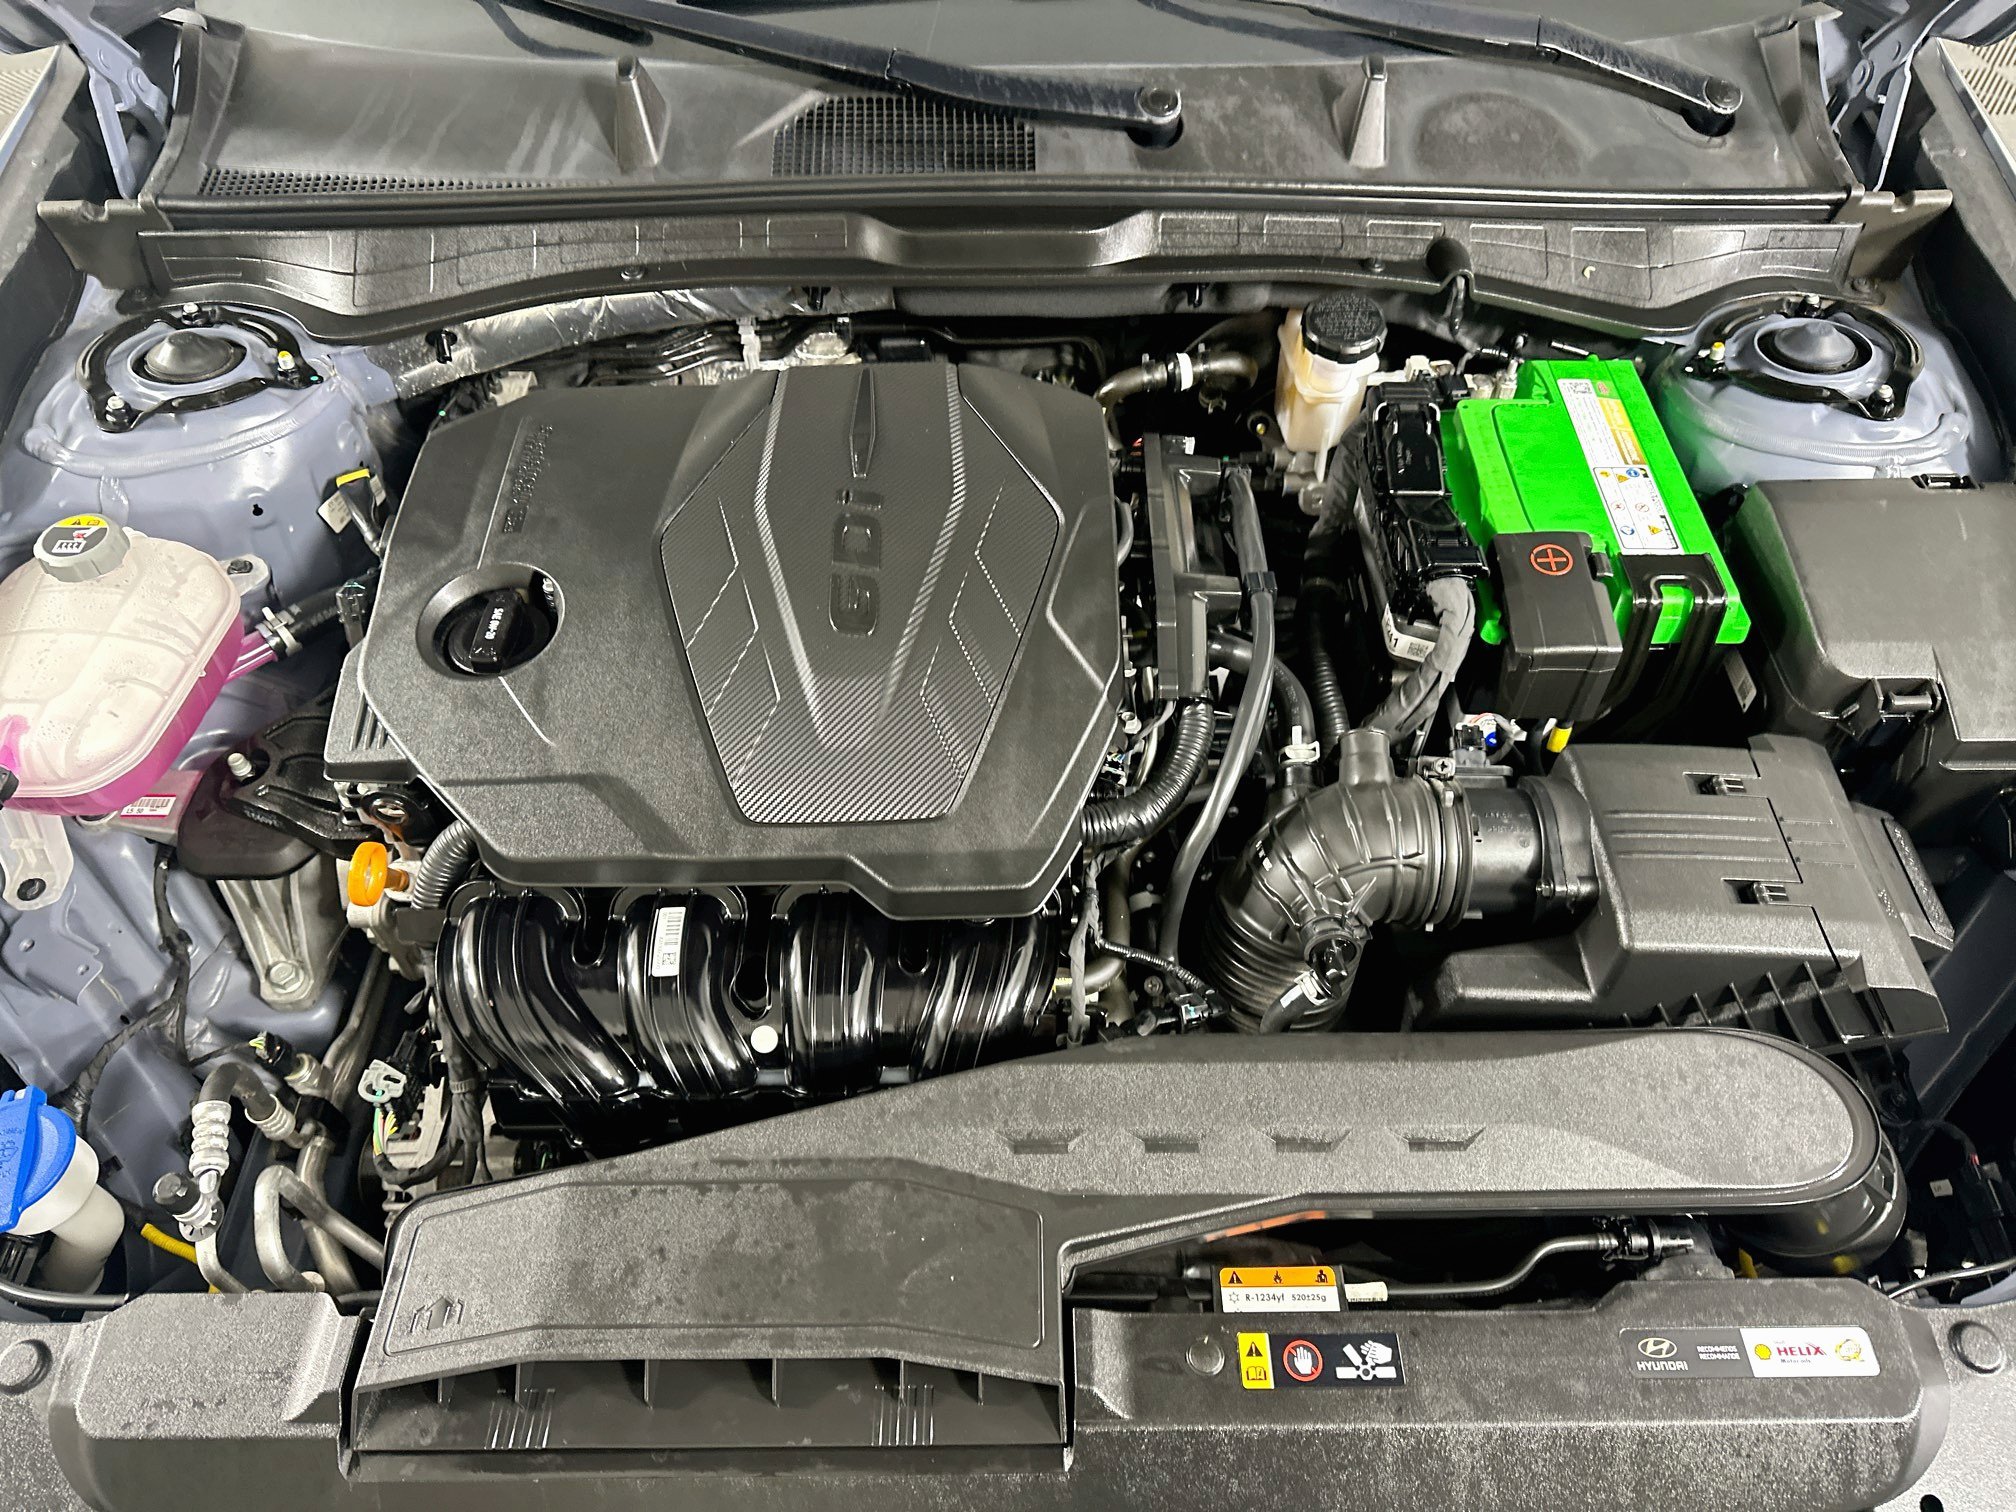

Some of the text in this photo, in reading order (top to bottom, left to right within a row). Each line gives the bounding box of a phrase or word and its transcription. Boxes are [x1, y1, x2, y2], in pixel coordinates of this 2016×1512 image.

[1245, 1293, 1327, 1303] R-1234yf 520±25g
[1776, 1345, 1826, 1356] HELIX
[1636, 1360, 1689, 1371] HYUNDAI
